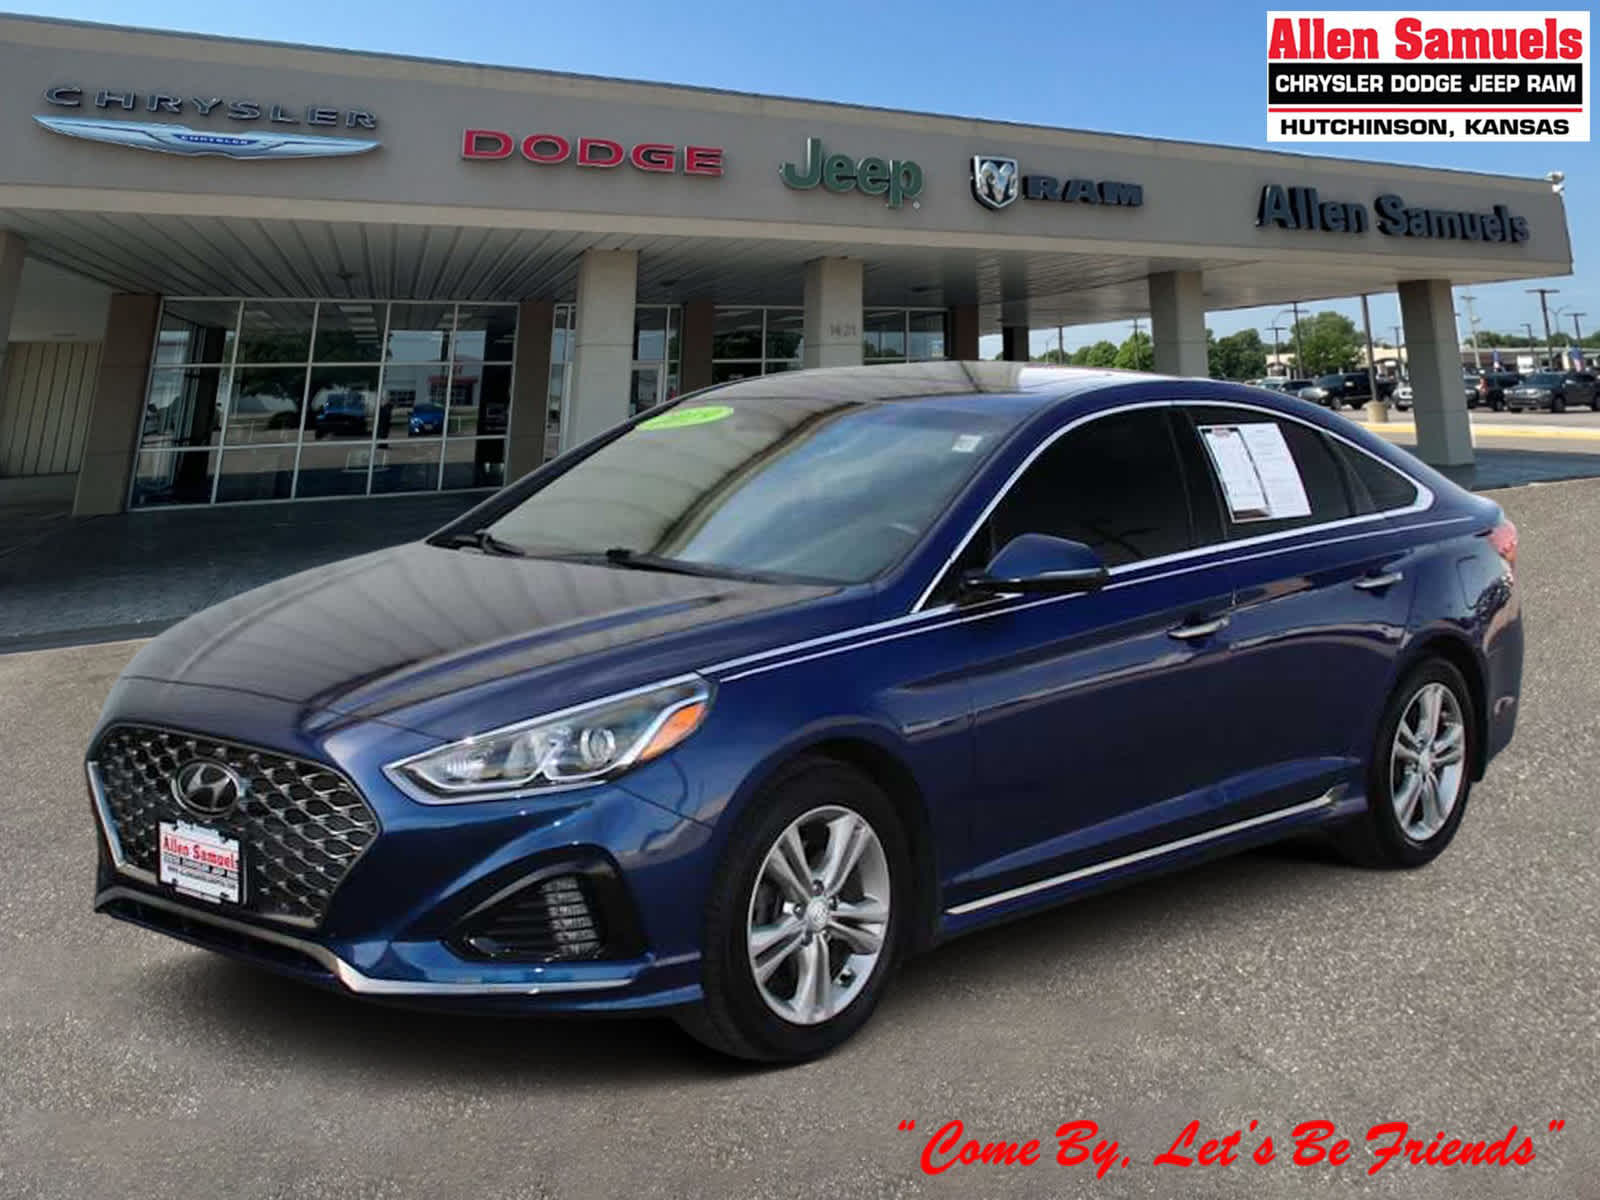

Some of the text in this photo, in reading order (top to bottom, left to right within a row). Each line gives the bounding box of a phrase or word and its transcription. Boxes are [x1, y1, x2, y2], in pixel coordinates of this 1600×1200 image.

[43, 86, 378, 129] CHRYSLER
[462, 128, 724, 177] DODGE
[779, 136, 924, 209] Jeep
[1022, 174, 1144, 207] RAM
[1255, 184, 1530, 243] Allen Samuels
